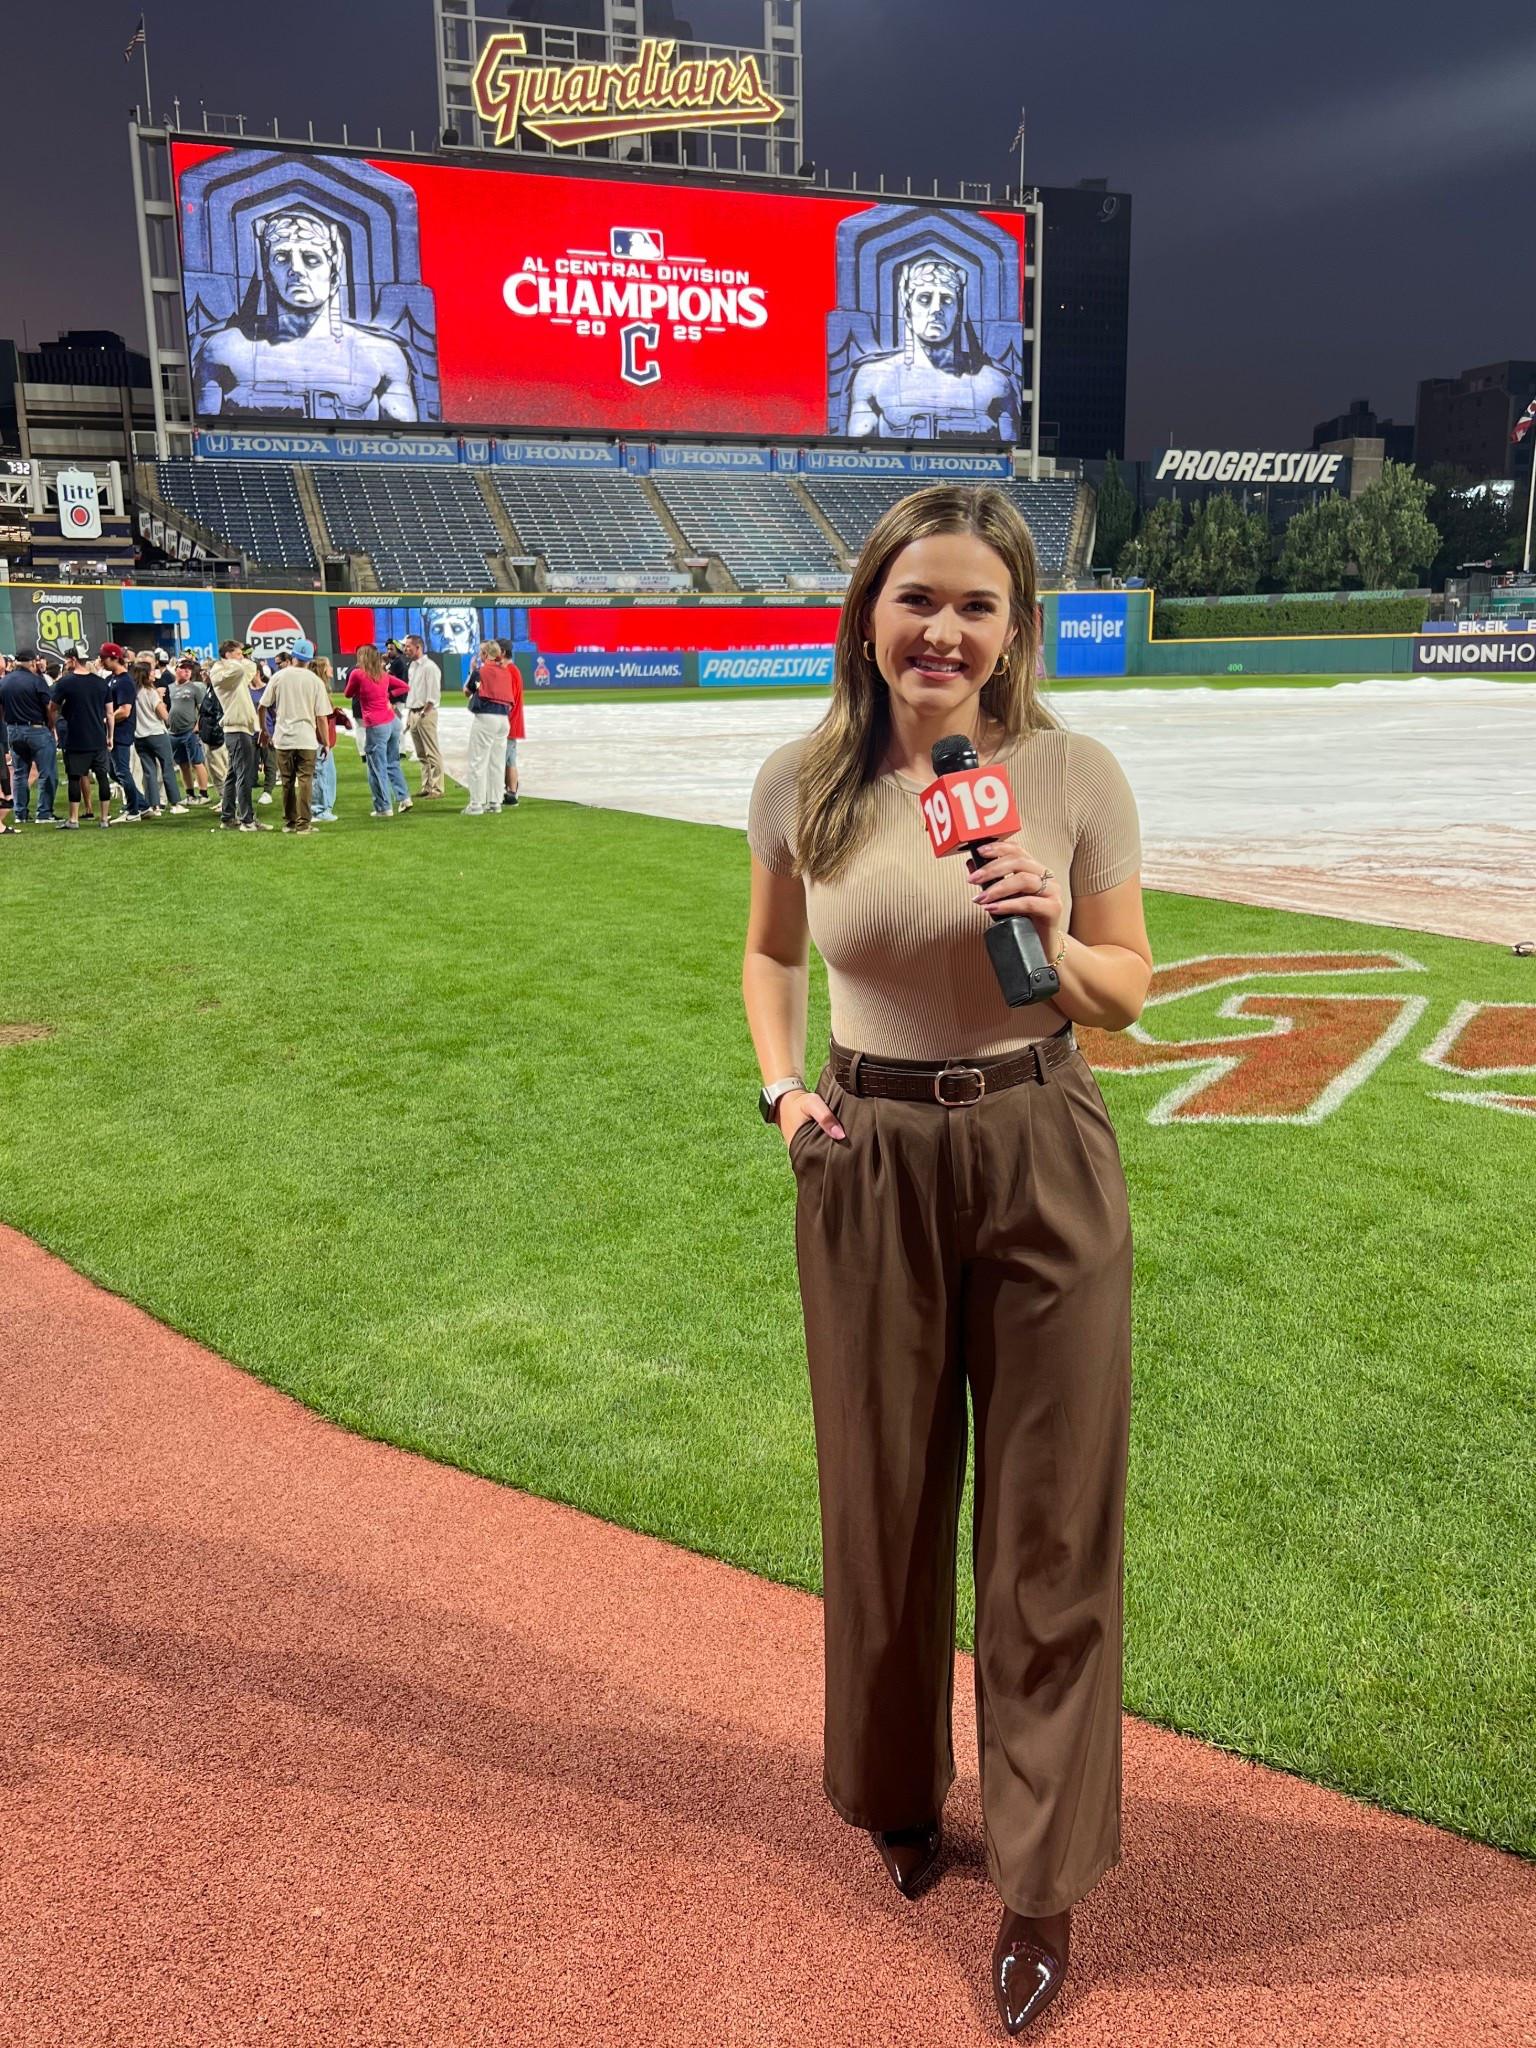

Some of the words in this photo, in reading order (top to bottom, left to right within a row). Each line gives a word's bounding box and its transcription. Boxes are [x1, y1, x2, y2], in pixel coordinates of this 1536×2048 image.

[472, 33, 785, 147] Guardians
[522, 257, 549, 273] AL
[555, 258, 652, 279] CENTRAL
[658, 266, 749, 285] DIVISION
[502, 272, 769, 328] CHAMPIONS
[576, 320, 606, 336] 20
[673, 326, 702, 341] 25
[620, 321, 661, 386] C
[231, 438, 330, 453] HONDA
[360, 441, 455, 457] HONDA
[524, 446, 613, 461] HONDA
[682, 451, 765, 466] HONDA
[827, 455, 905, 470] HONDA
[929, 458, 1003, 472] HONDA
[1155, 449, 1343, 483] PROGRESSIVE
[61, 484, 94, 504] Lite
[39, 594, 83, 604] ENBRIDGE
[40, 610, 80, 640] 811
[1061, 613, 1123, 643] meijer
[251, 636, 302, 650] PEPS
[703, 657, 832, 679] PROGRESSIVE
[1227, 663, 1243, 672] 400
[950, 776, 1009, 831] 19
[924, 790, 952, 847] 19
